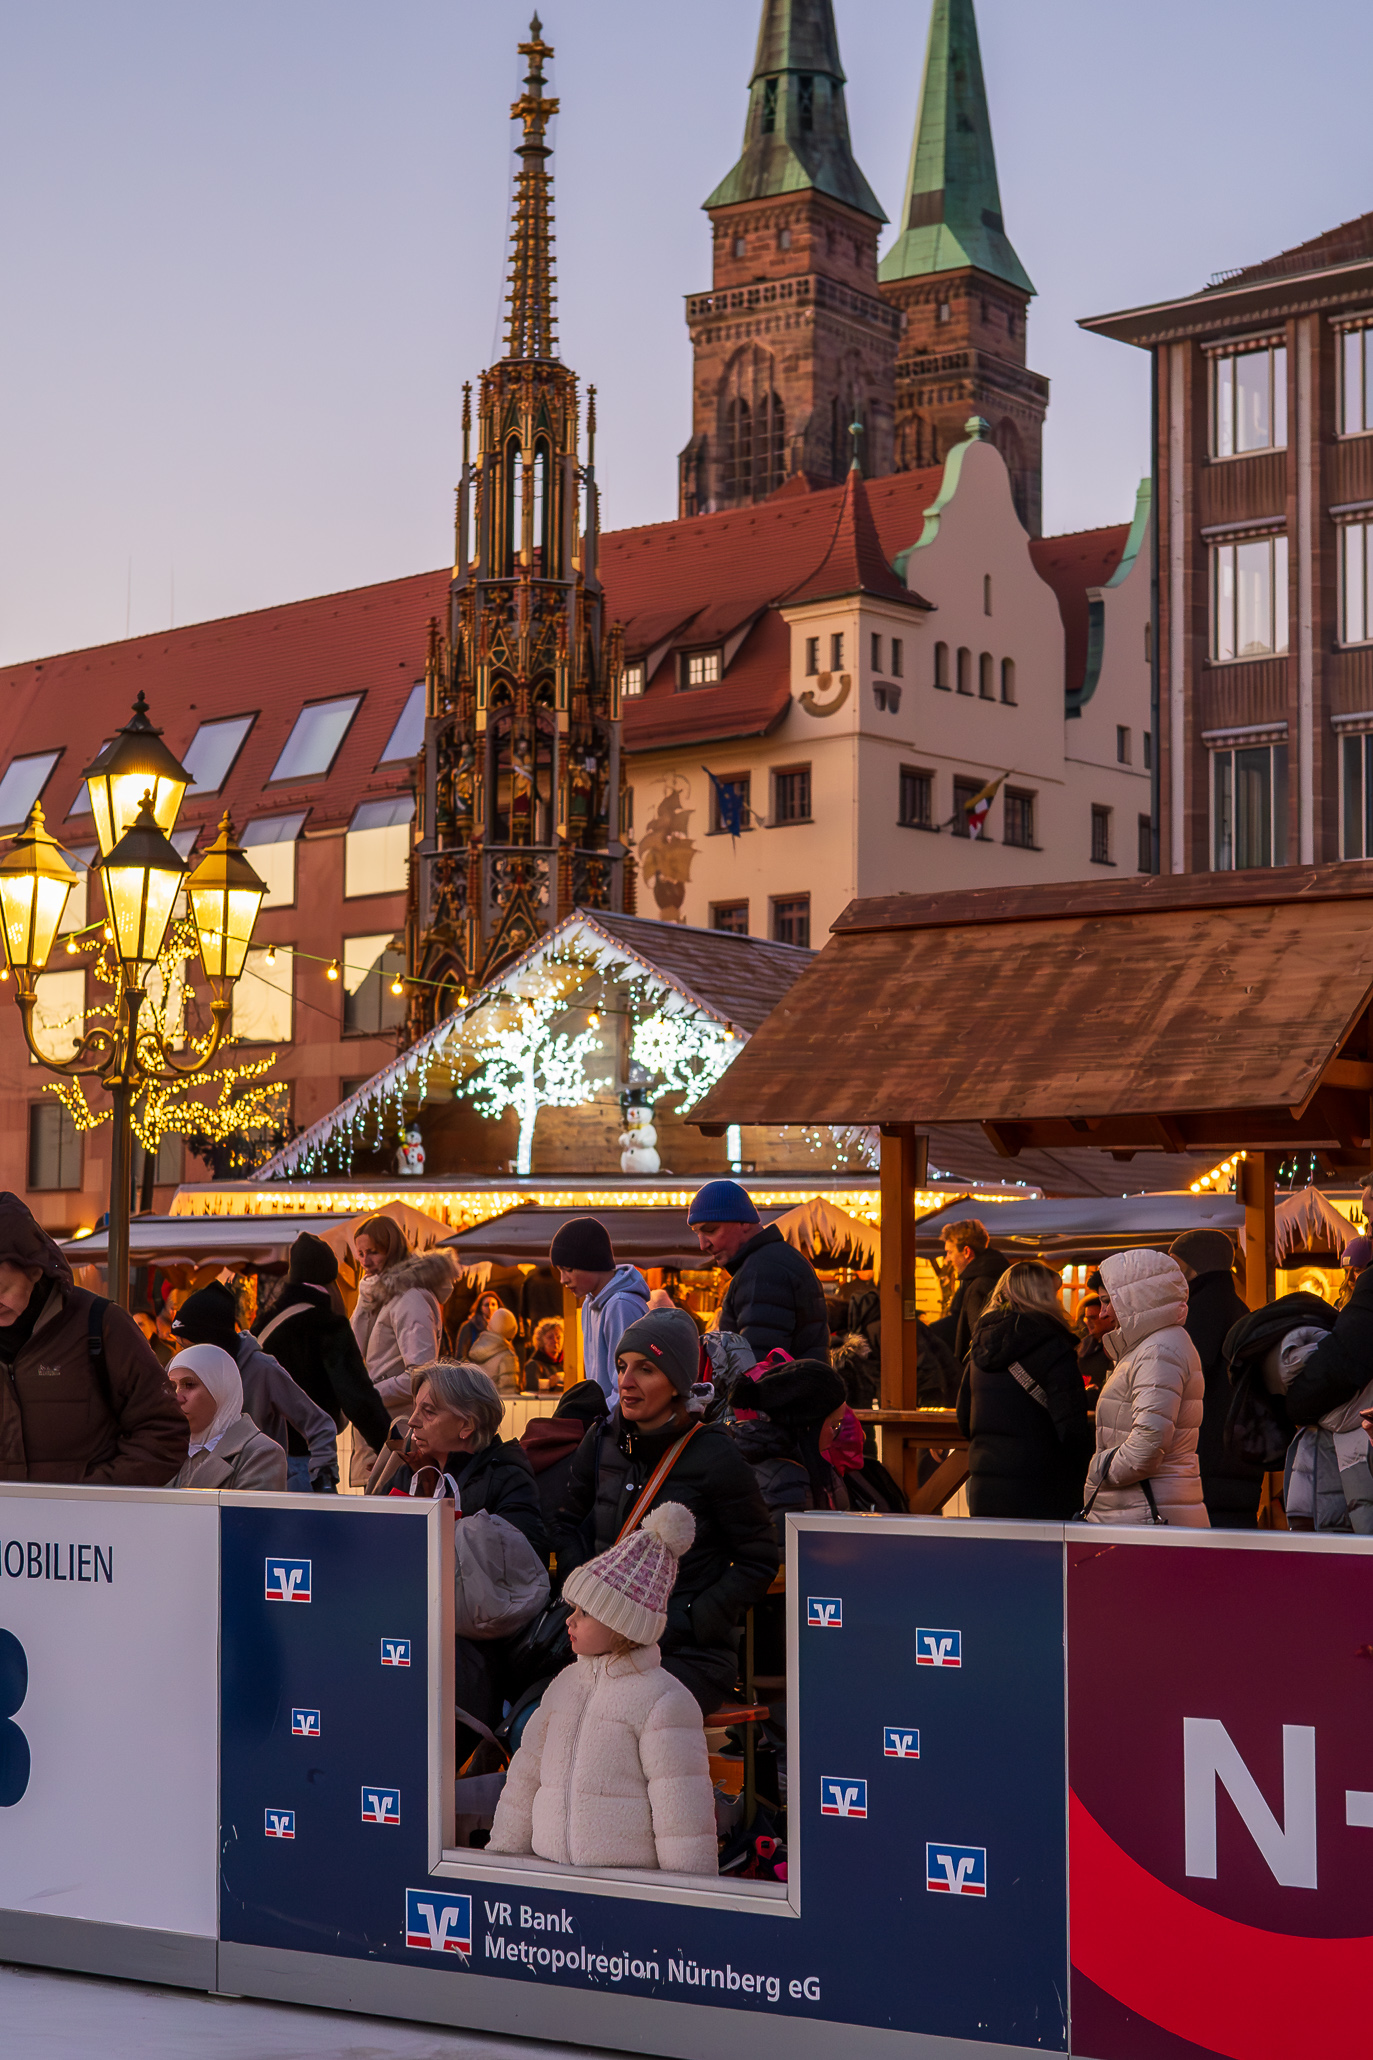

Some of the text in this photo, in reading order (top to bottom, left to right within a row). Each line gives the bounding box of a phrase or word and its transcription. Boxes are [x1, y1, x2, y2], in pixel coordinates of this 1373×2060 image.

[0, 1540, 113, 1583] OBILIEN
[484, 1901, 574, 1934] VR Bank
[485, 1935, 821, 2002] Metropolregion Nürnberg eG
